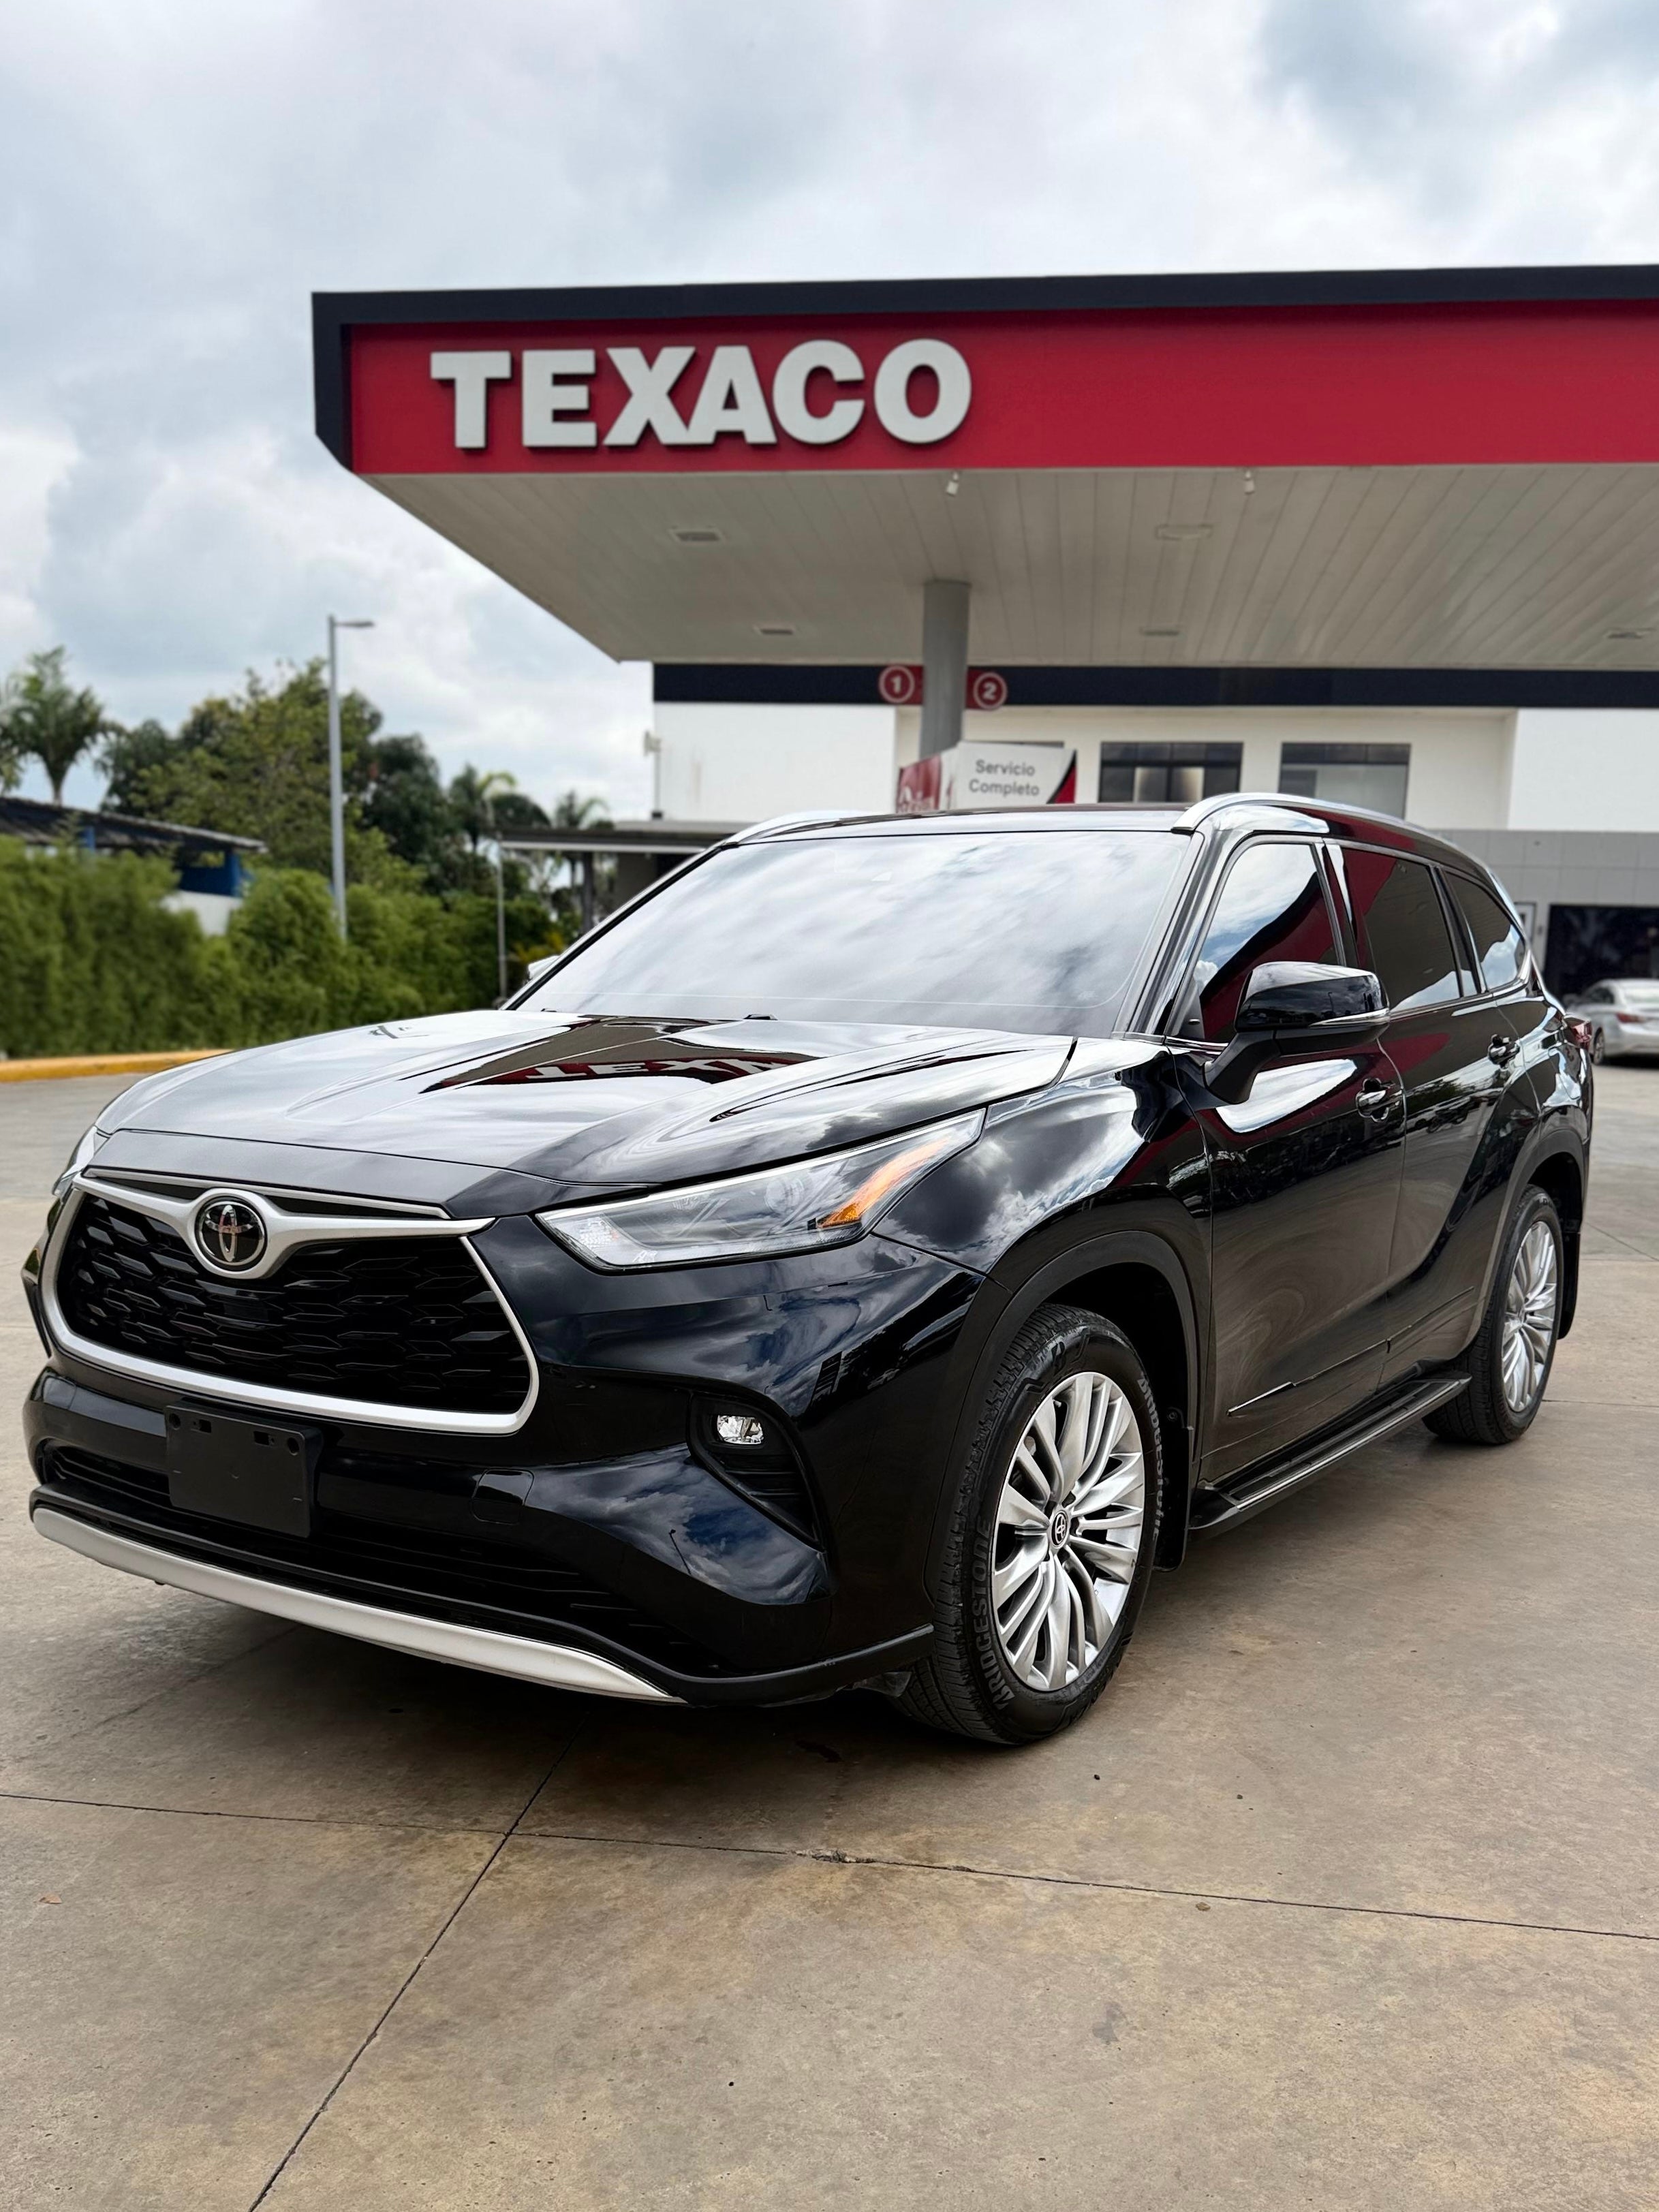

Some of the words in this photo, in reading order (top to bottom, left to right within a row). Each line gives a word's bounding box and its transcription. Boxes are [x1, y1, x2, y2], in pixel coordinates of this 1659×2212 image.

[431, 339, 972, 449] TEXACO
[982, 681, 995, 700] 2
[975, 760, 1036, 777] Servicio
[969, 779, 1040, 798] Completo
[972, 1514, 1016, 1711] BRIDGESTONE
